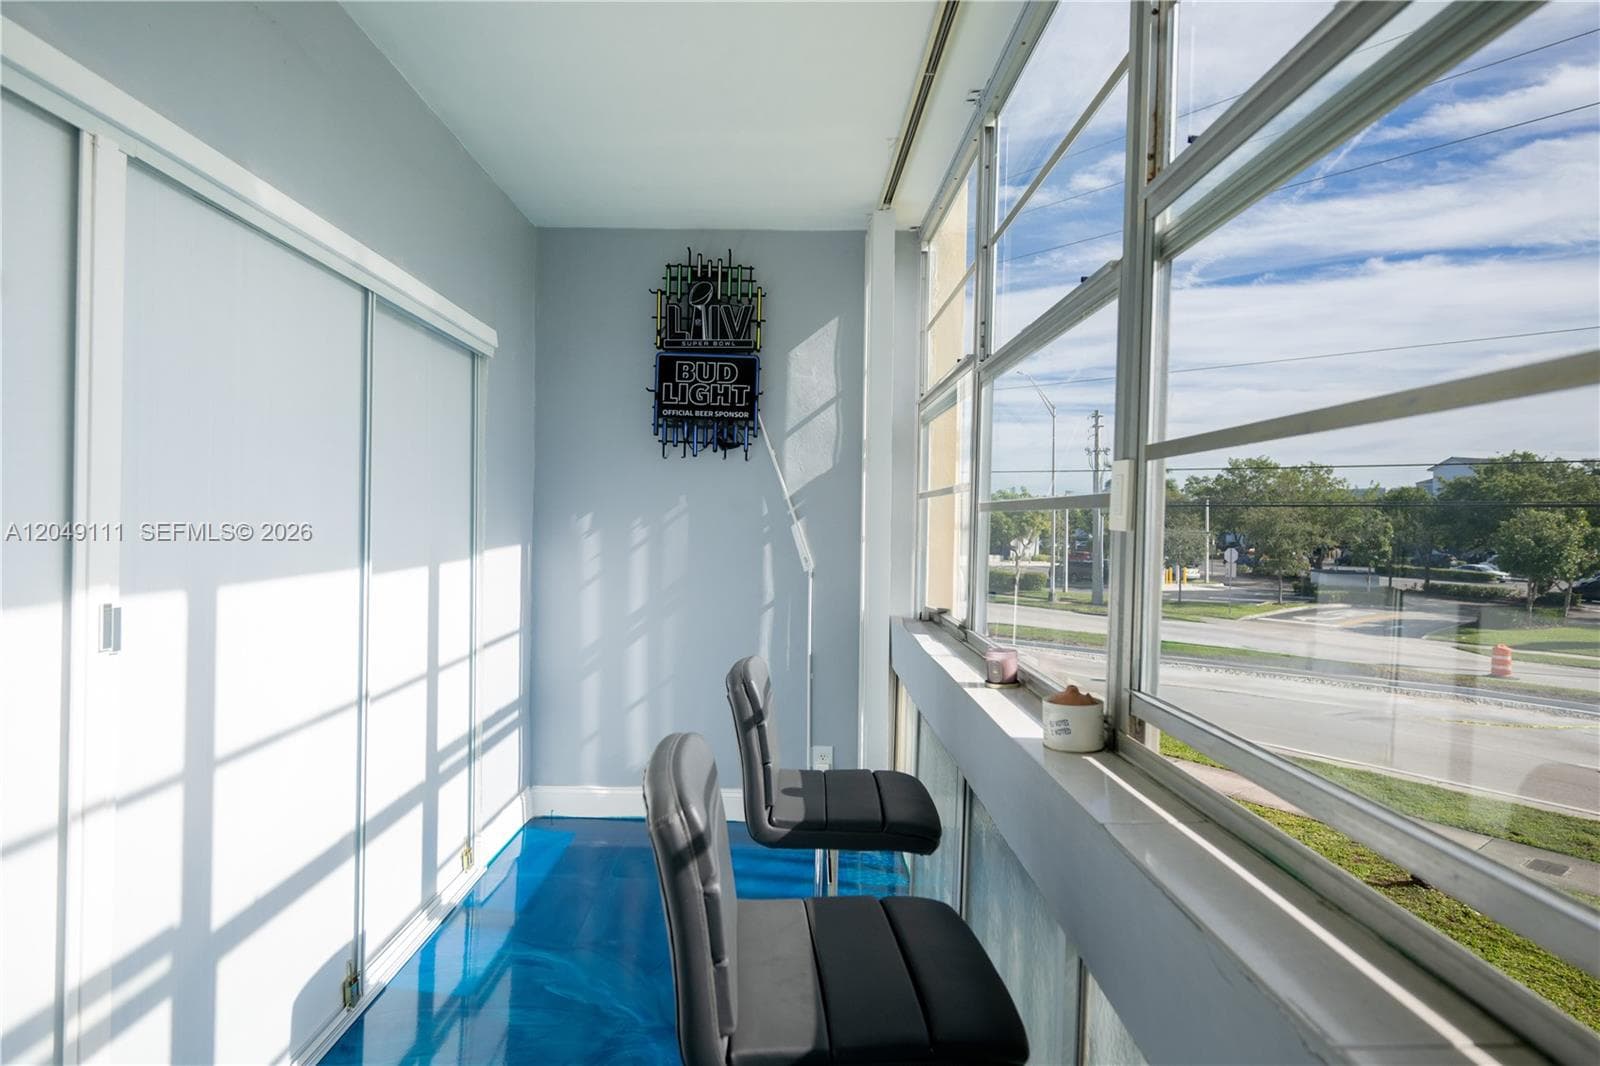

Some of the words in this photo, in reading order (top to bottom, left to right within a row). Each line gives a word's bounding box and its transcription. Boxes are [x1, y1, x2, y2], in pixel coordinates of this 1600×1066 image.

[675, 361, 738, 384] BUD
[662, 383, 750, 406] LIGHT
[662, 409, 694, 417] OFFICIAL
[715, 410, 750, 418] SPONSOR
